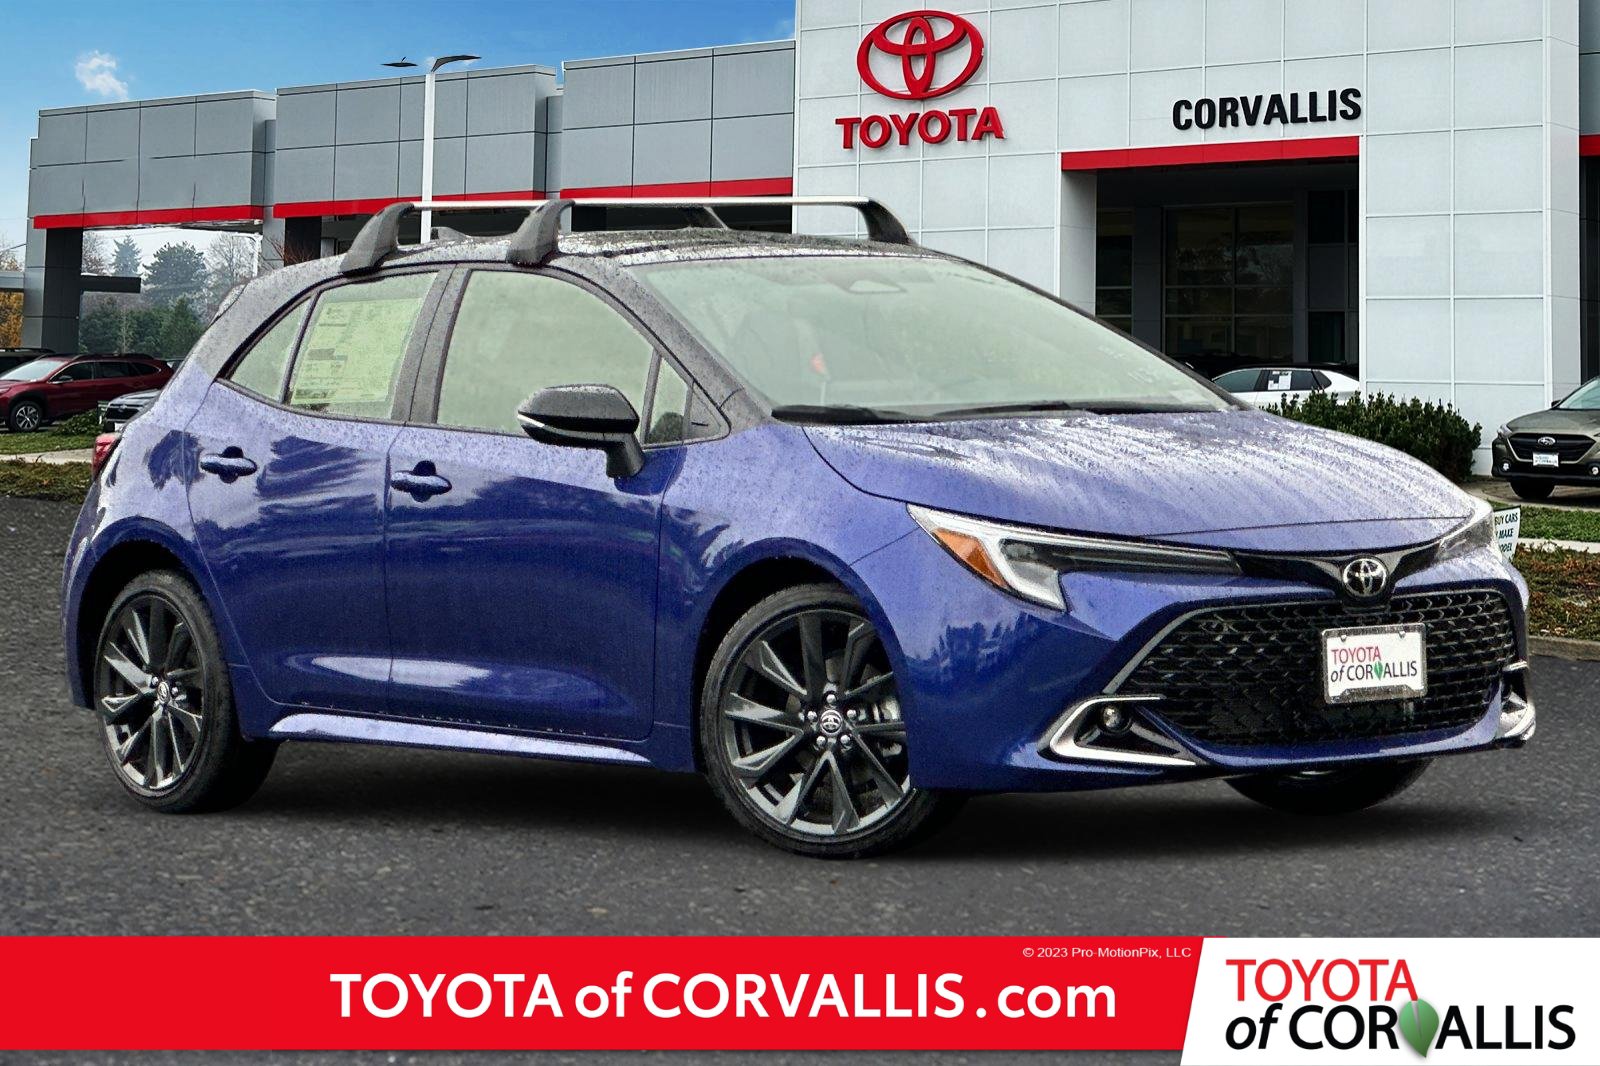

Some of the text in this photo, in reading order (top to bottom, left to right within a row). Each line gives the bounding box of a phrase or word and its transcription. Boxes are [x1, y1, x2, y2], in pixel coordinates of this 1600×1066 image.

[1172, 88, 1362, 131] CORVALLIS
[836, 106, 1005, 150] TOYOTA
[1505, 512, 1518, 523] CARS
[1500, 542, 1513, 553] ODEL
[1331, 646, 1382, 665] TOYOTA
[1331, 665, 1345, 682] of
